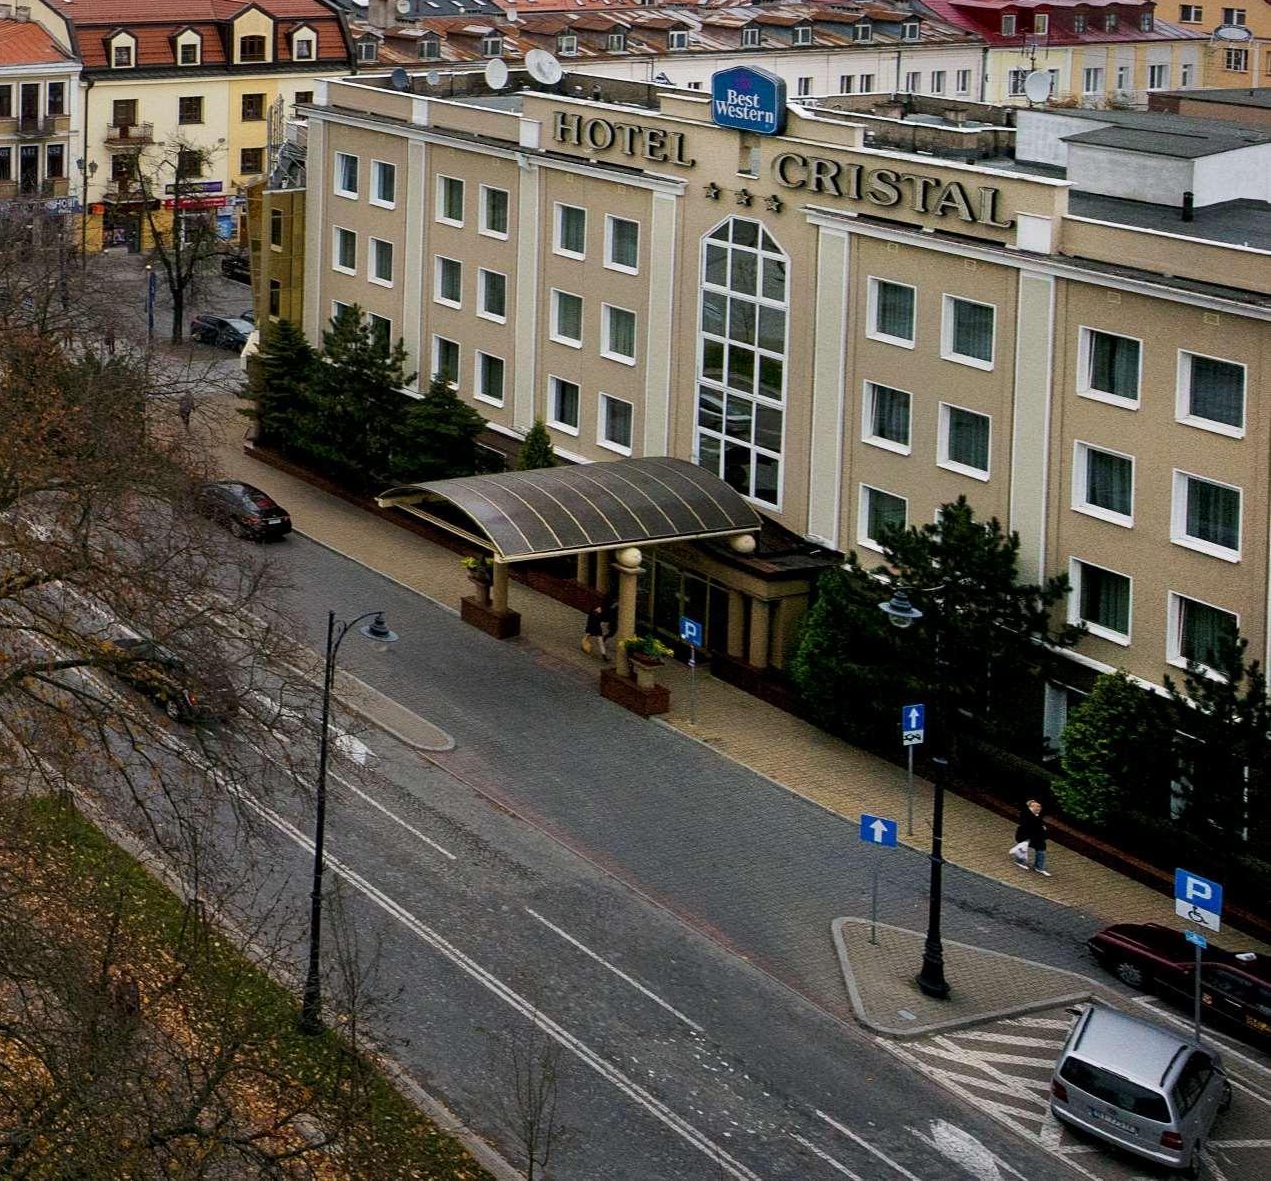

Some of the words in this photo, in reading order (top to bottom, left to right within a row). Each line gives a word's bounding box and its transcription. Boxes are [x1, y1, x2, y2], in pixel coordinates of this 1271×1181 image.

[726, 88, 761, 108] Best
[715, 99, 775, 124] Western
[552, 110, 697, 168] HOTEL
[771, 152, 1015, 229] CRISTAL
[685, 621, 697, 637] P
[1186, 876, 1212, 900] P
